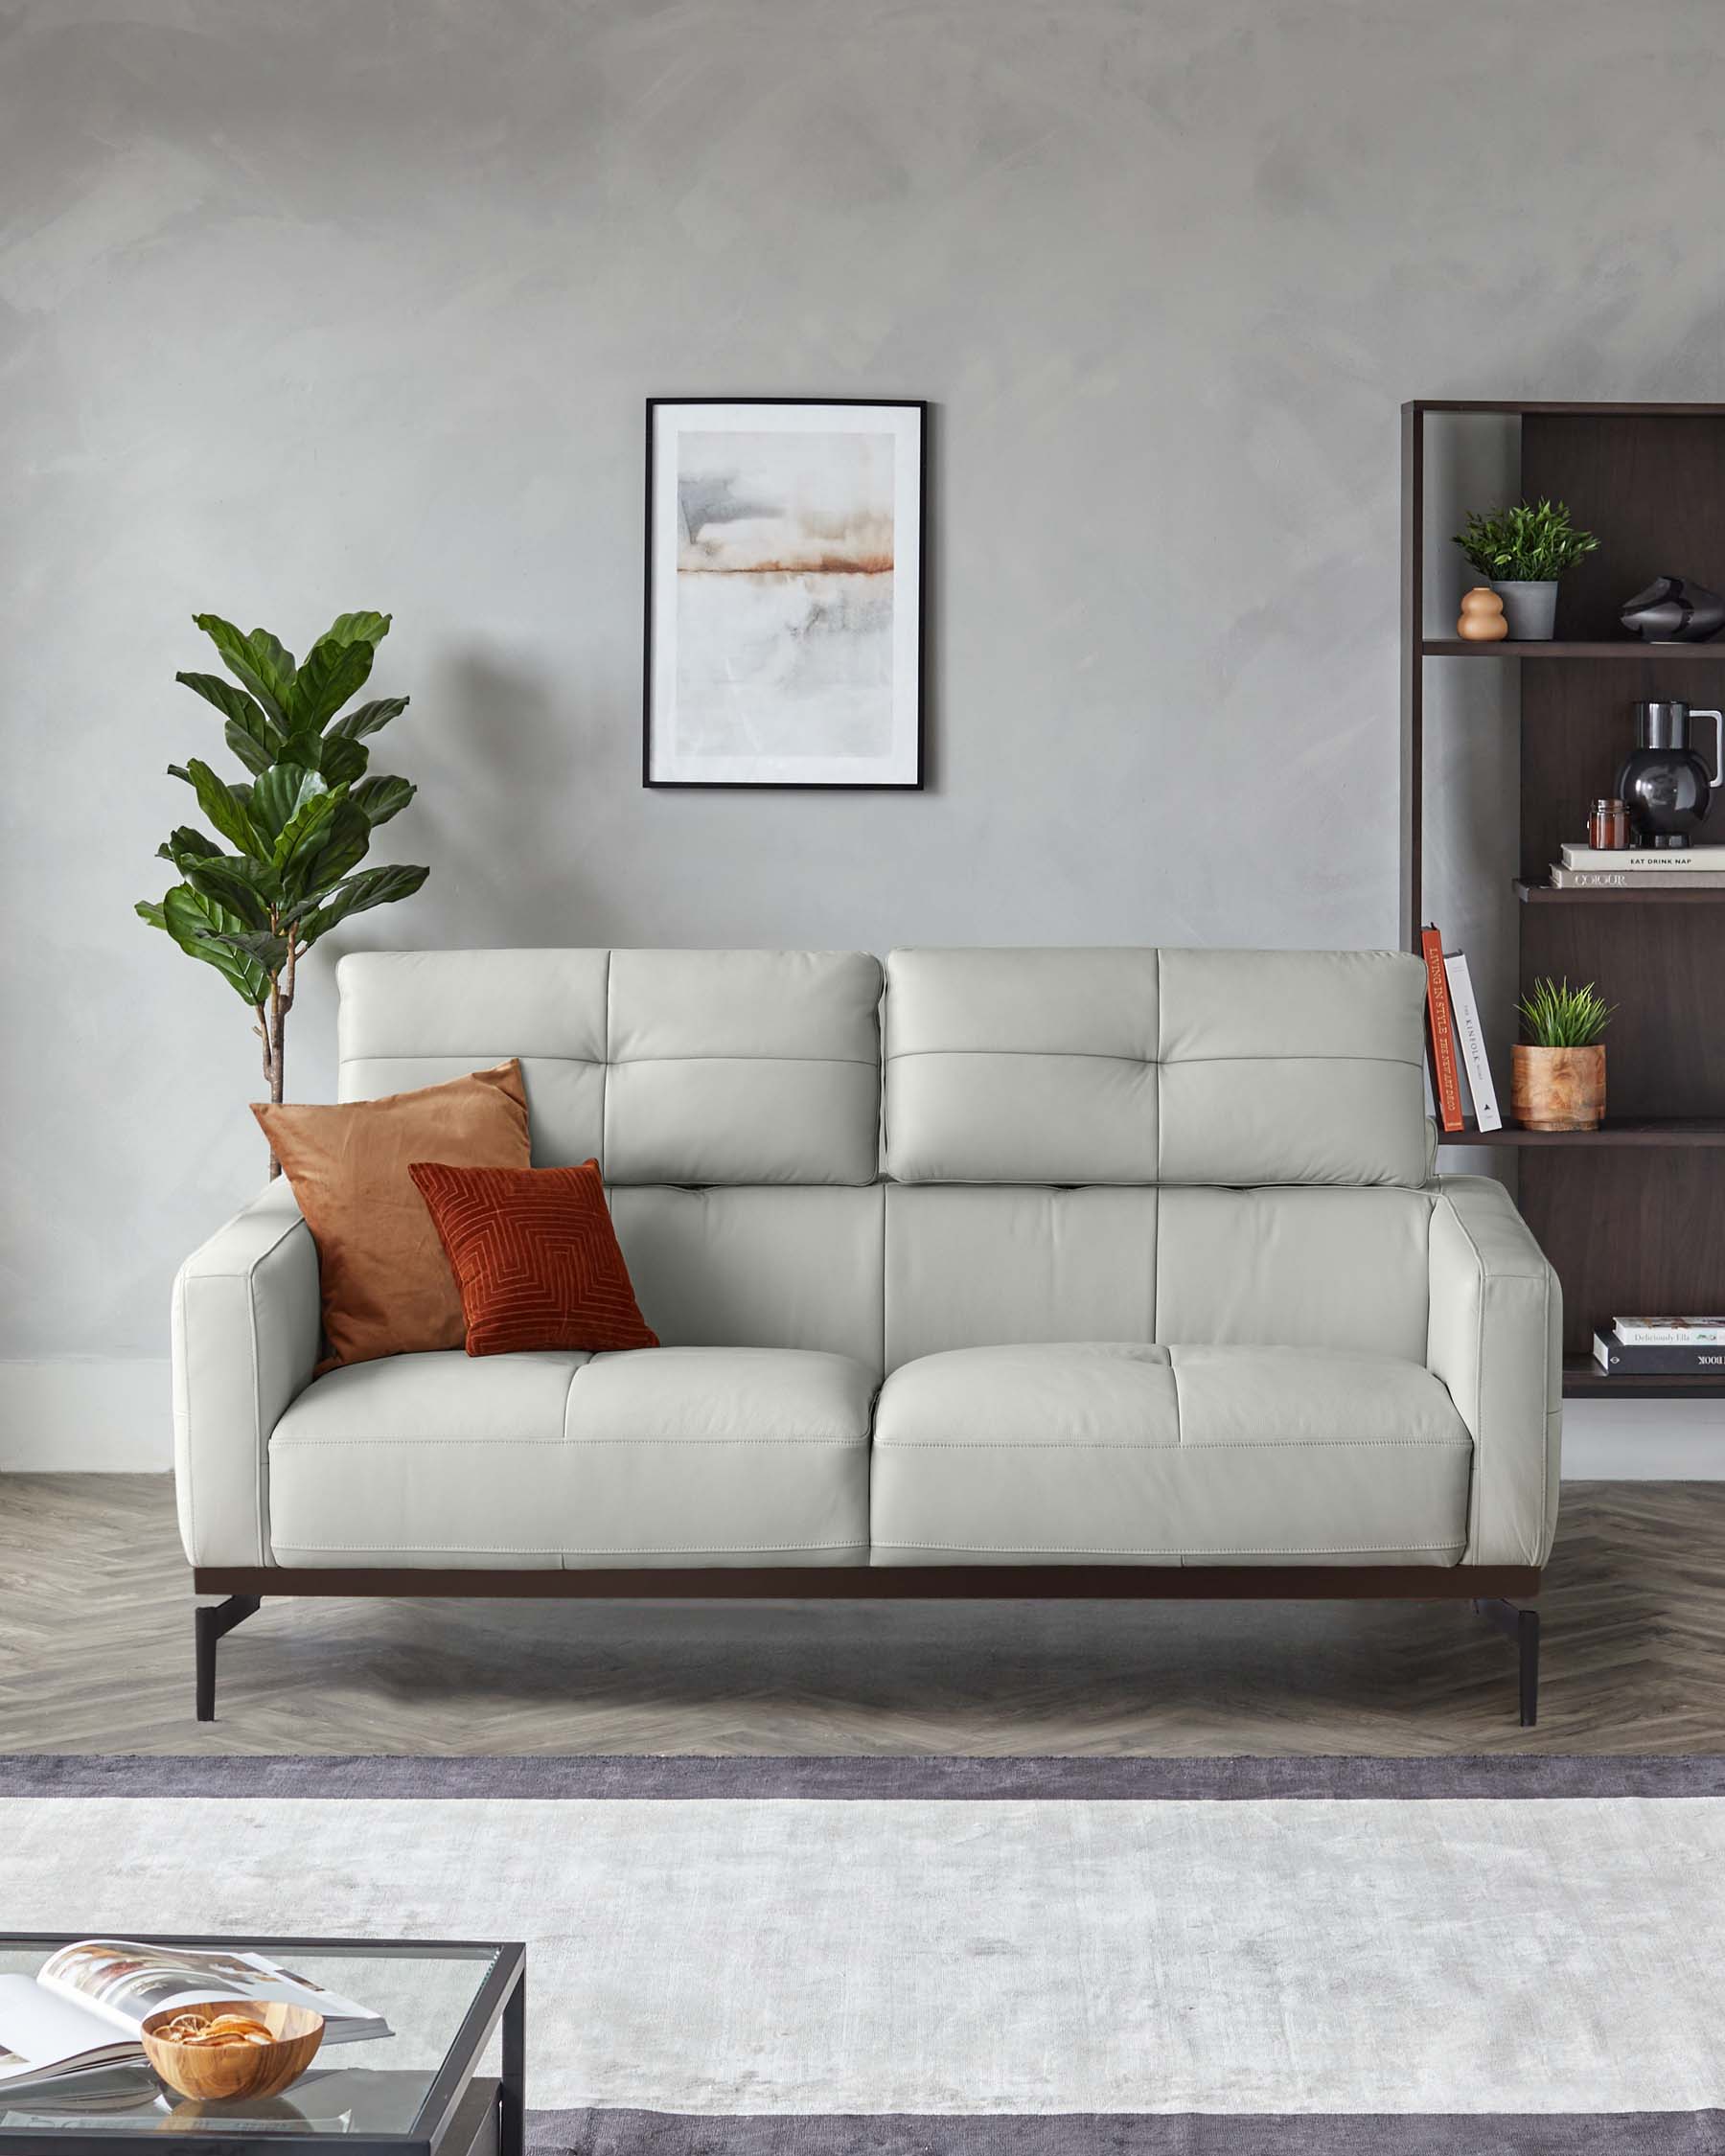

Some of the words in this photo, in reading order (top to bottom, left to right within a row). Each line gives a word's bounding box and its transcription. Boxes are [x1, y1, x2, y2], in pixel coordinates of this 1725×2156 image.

[1576, 874, 1626, 885] COLOUR
[1429, 948, 1441, 984] LIVING
[1434, 986, 1443, 998] IN
[1436, 1001, 1447, 1034] STYLE
[1466, 1019, 1480, 1062] KINFOLK
[1635, 1333, 1674, 1342] Deliciously
[1676, 1333, 1690, 1342] Ella
